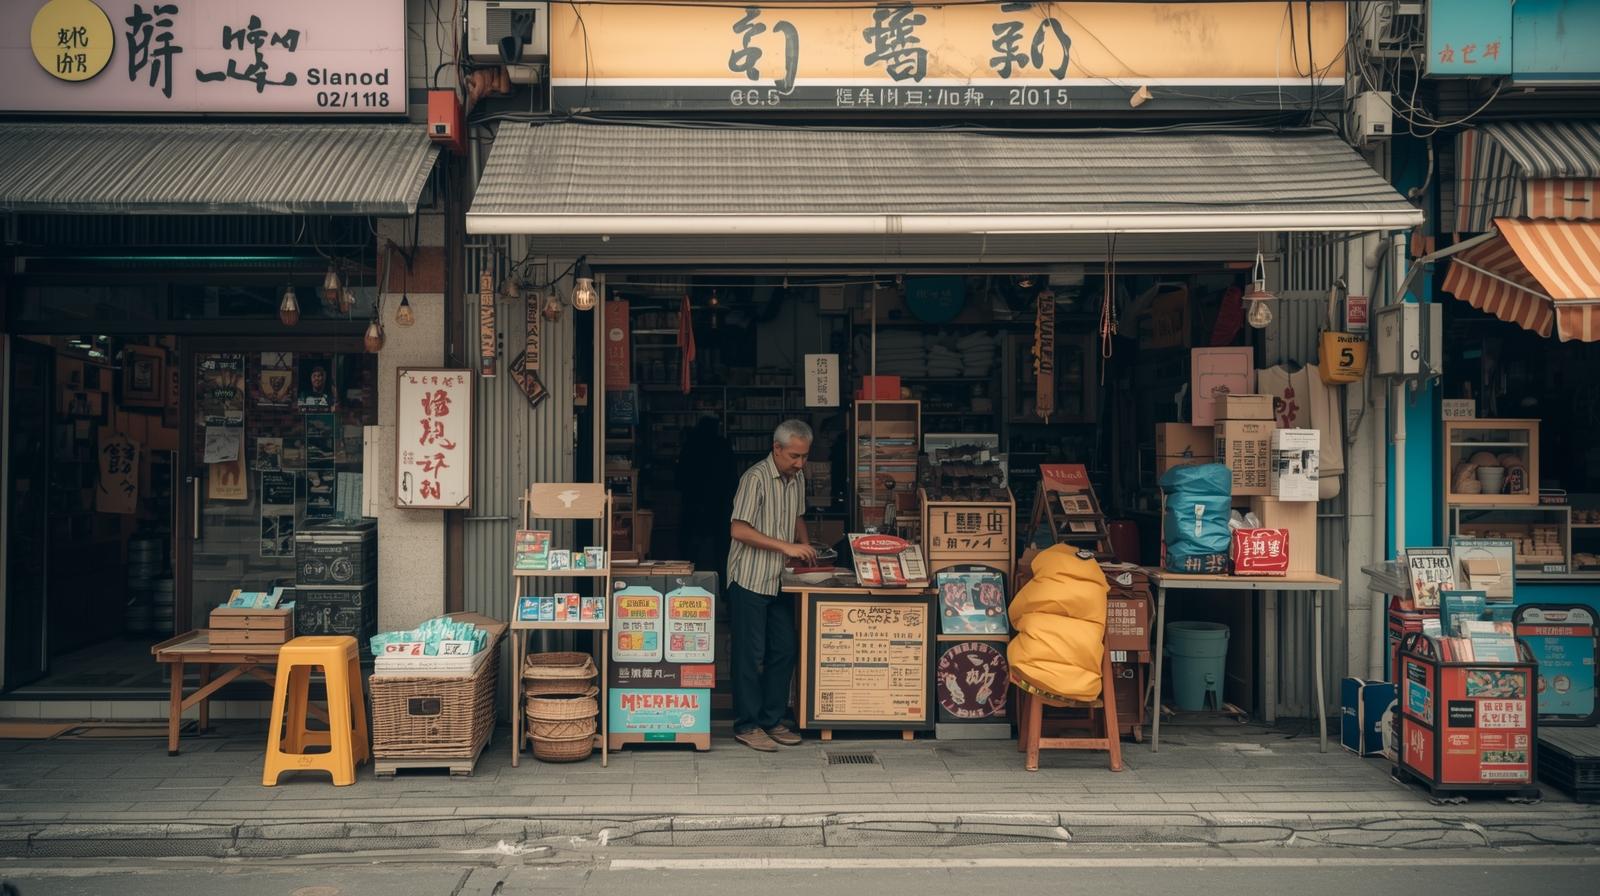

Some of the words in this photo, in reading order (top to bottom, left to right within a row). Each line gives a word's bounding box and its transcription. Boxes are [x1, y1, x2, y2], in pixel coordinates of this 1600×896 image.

[307, 68, 388, 85] Slanod
[317, 91, 389, 107] 02/1118
[1339, 348, 1354, 367] 5
